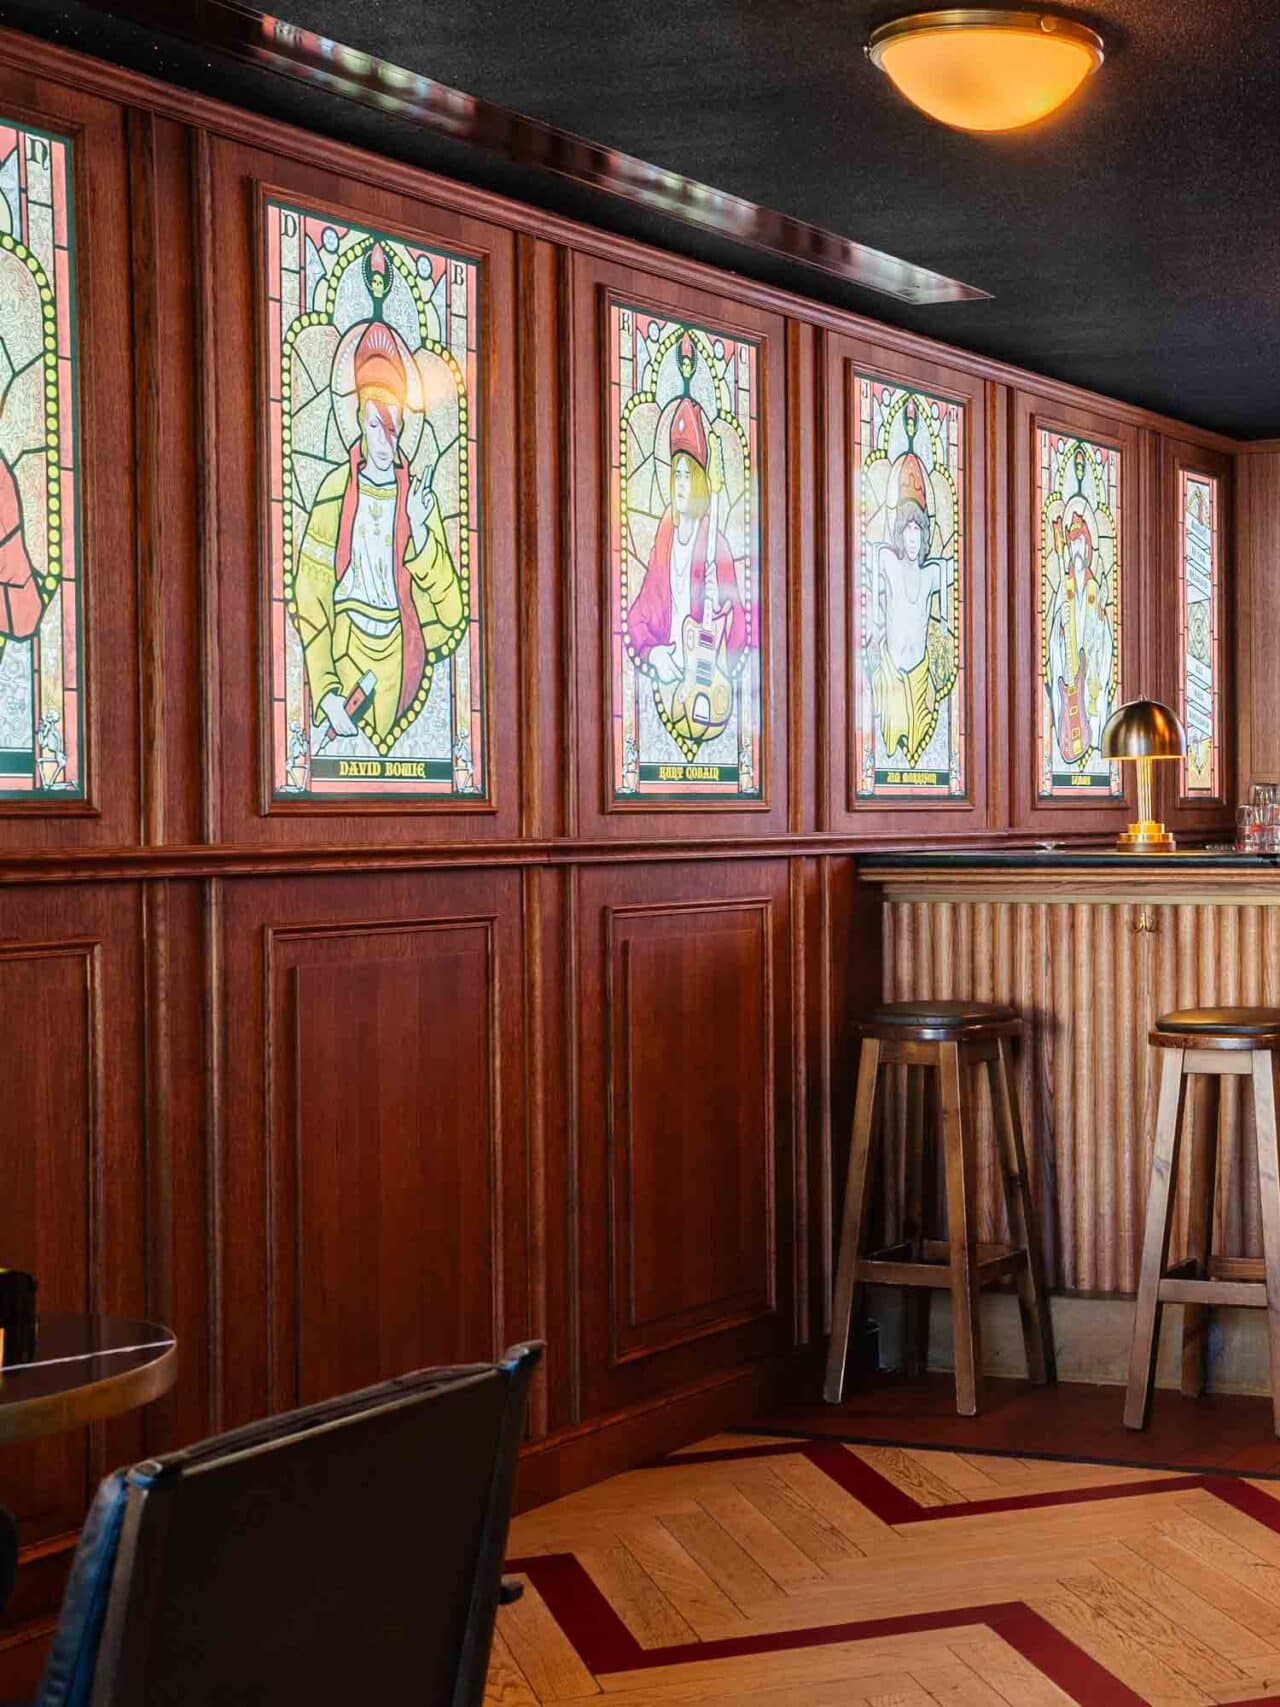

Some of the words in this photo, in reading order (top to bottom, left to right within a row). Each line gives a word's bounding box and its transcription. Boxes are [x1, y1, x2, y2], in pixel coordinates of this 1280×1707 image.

[281, 213, 298, 238] D
[452, 264, 465, 287] B
[340, 761, 380, 776] DAVID
